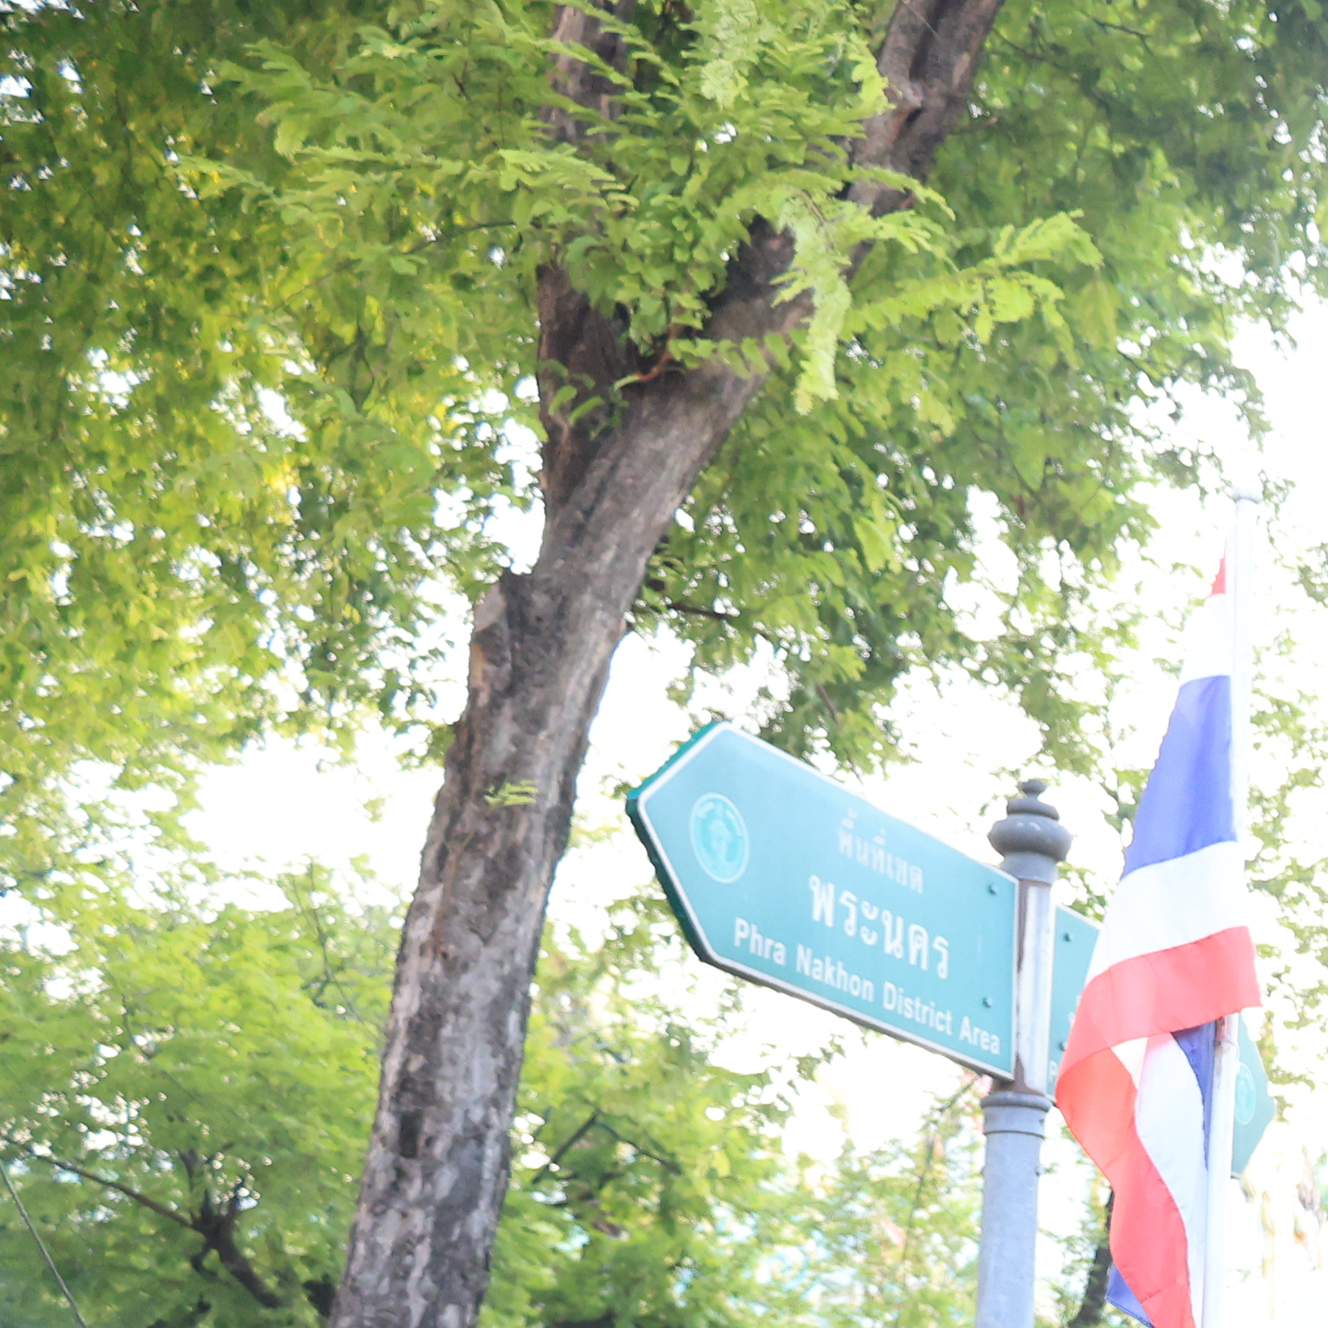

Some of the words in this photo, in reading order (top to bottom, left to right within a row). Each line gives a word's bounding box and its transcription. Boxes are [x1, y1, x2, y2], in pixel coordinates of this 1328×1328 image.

[734, 916, 786, 966] Phra
[796, 943, 875, 1002] Nakhon
[883, 980, 953, 1035] District
[960, 1015, 1000, 1055] Area
[809, 875, 949, 979] พระนคร
